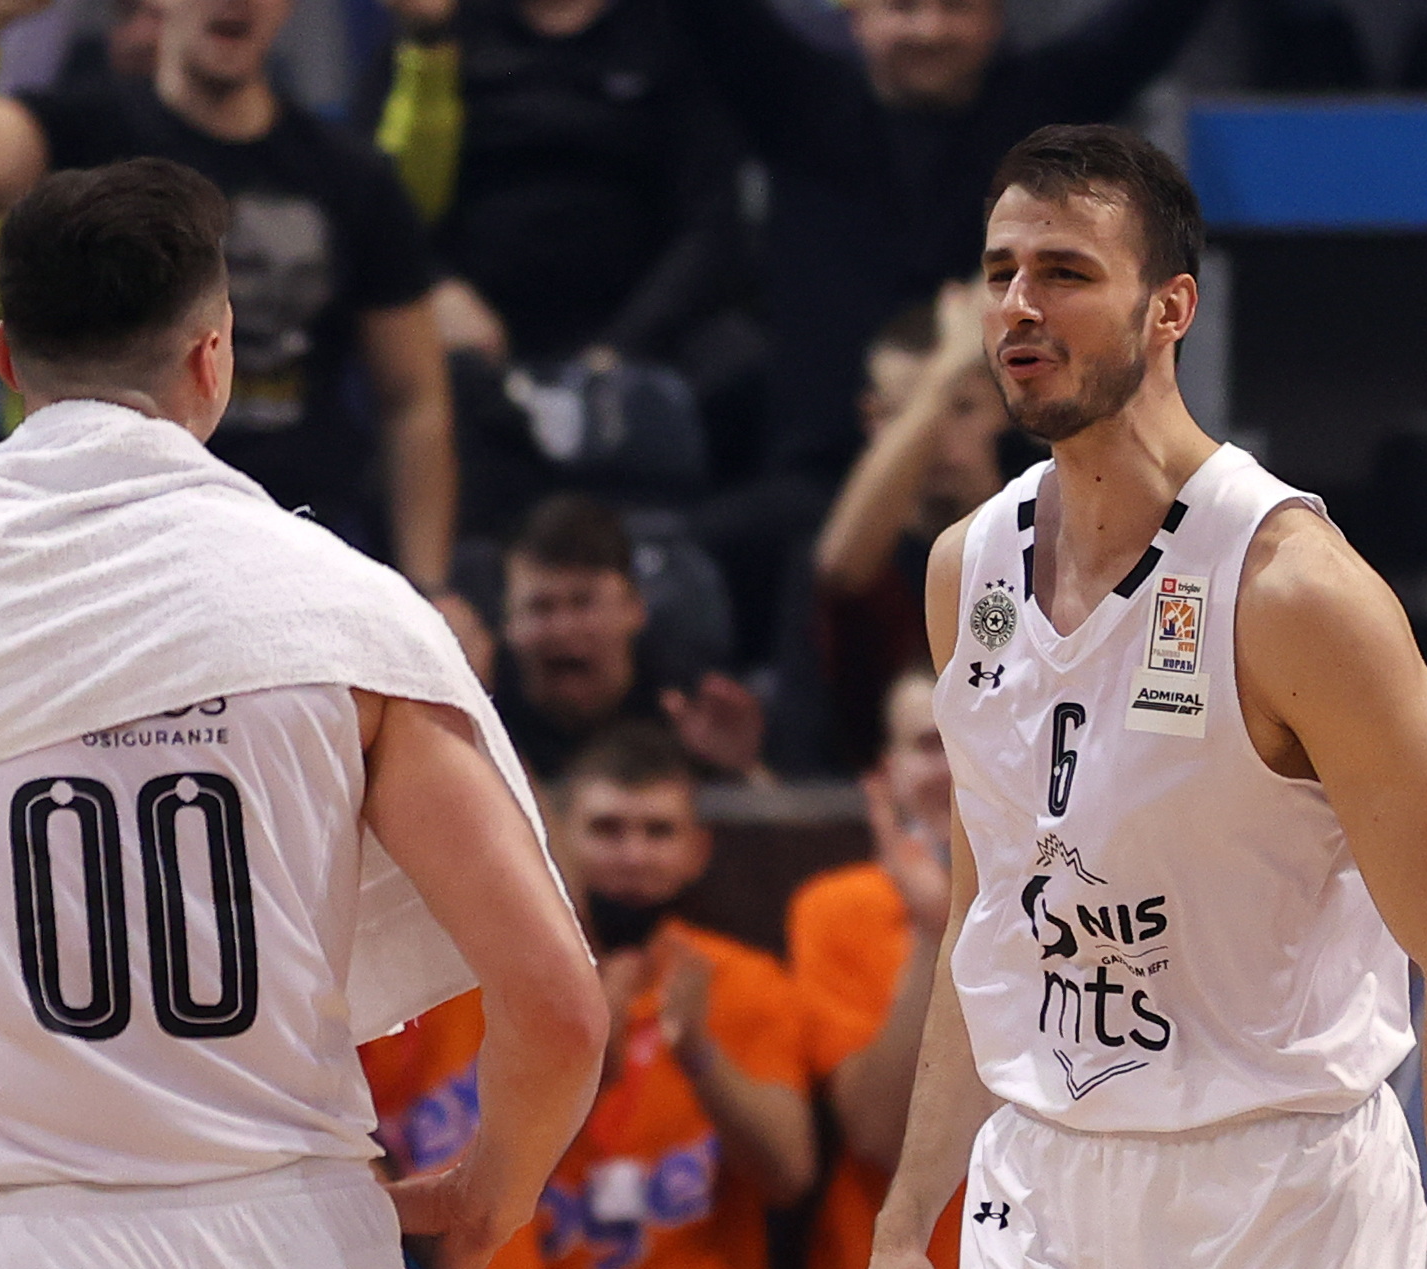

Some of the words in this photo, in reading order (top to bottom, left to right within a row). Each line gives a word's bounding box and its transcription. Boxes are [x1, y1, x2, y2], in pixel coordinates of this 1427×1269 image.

[1138, 688, 1204, 706] ADMIRAL
[1177, 705, 1204, 716] BET
[82, 728, 229, 748] OSIGURANJE
[1048, 702, 1086, 817] 6
[9, 772, 258, 1041] 00
[1076, 895, 1167, 944] NIS
[1039, 966, 1170, 1051] mts
